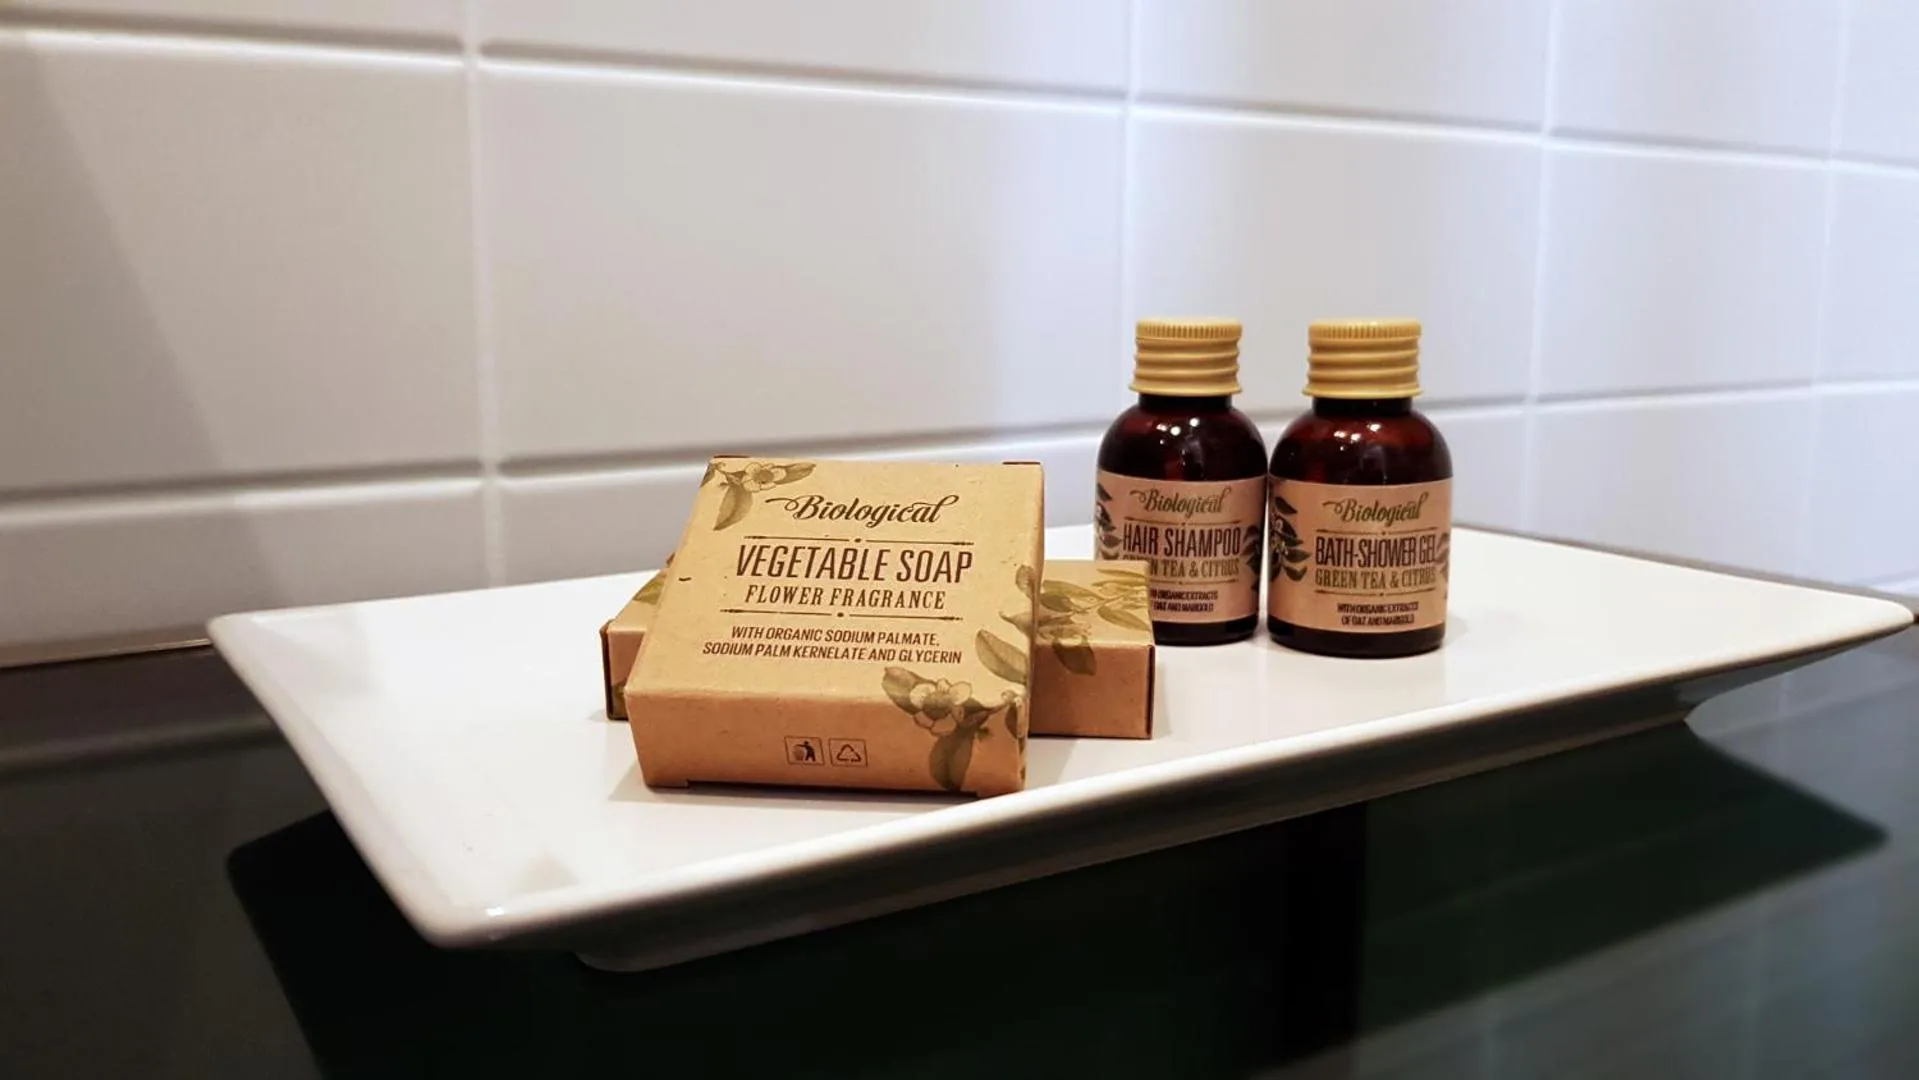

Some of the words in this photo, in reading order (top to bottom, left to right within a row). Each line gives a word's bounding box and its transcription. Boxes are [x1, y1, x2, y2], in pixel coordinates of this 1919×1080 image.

[765, 494, 960, 528] Biological
[1129, 486, 1233, 518] Biological
[1322, 491, 1429, 527] Biological
[1122, 522, 1159, 556] HAIR
[1164, 527, 1241, 557] SHAMPOO
[1315, 534, 1416, 569] BATH-SHOWER
[1419, 534, 1438, 565] GEL
[736, 544, 890, 582] VEGETABLE
[896, 549, 973, 584] SOAP
[1162, 560, 1185, 577] TEA
[1188, 560, 1199, 577] &
[1201, 559, 1240, 578] CITRUS
[1315, 568, 1356, 588] GREEN
[1361, 571, 1386, 590] TEA
[1389, 571, 1400, 588] &
[1401, 566, 1436, 587] CITRUS
[745, 584, 824, 606] FLOWER
[829, 588, 946, 610] FRAGRANCE
[731, 625, 763, 639] WITH
[765, 627, 823, 642] ORGANIC
[824, 631, 875, 644] SODIUM
[702, 641, 753, 656] SODIUM
[755, 644, 791, 658] PALM
[792, 646, 866, 661] KERNELATE
[868, 649, 896, 662] AND
[899, 650, 962, 665] GLYCERIN
